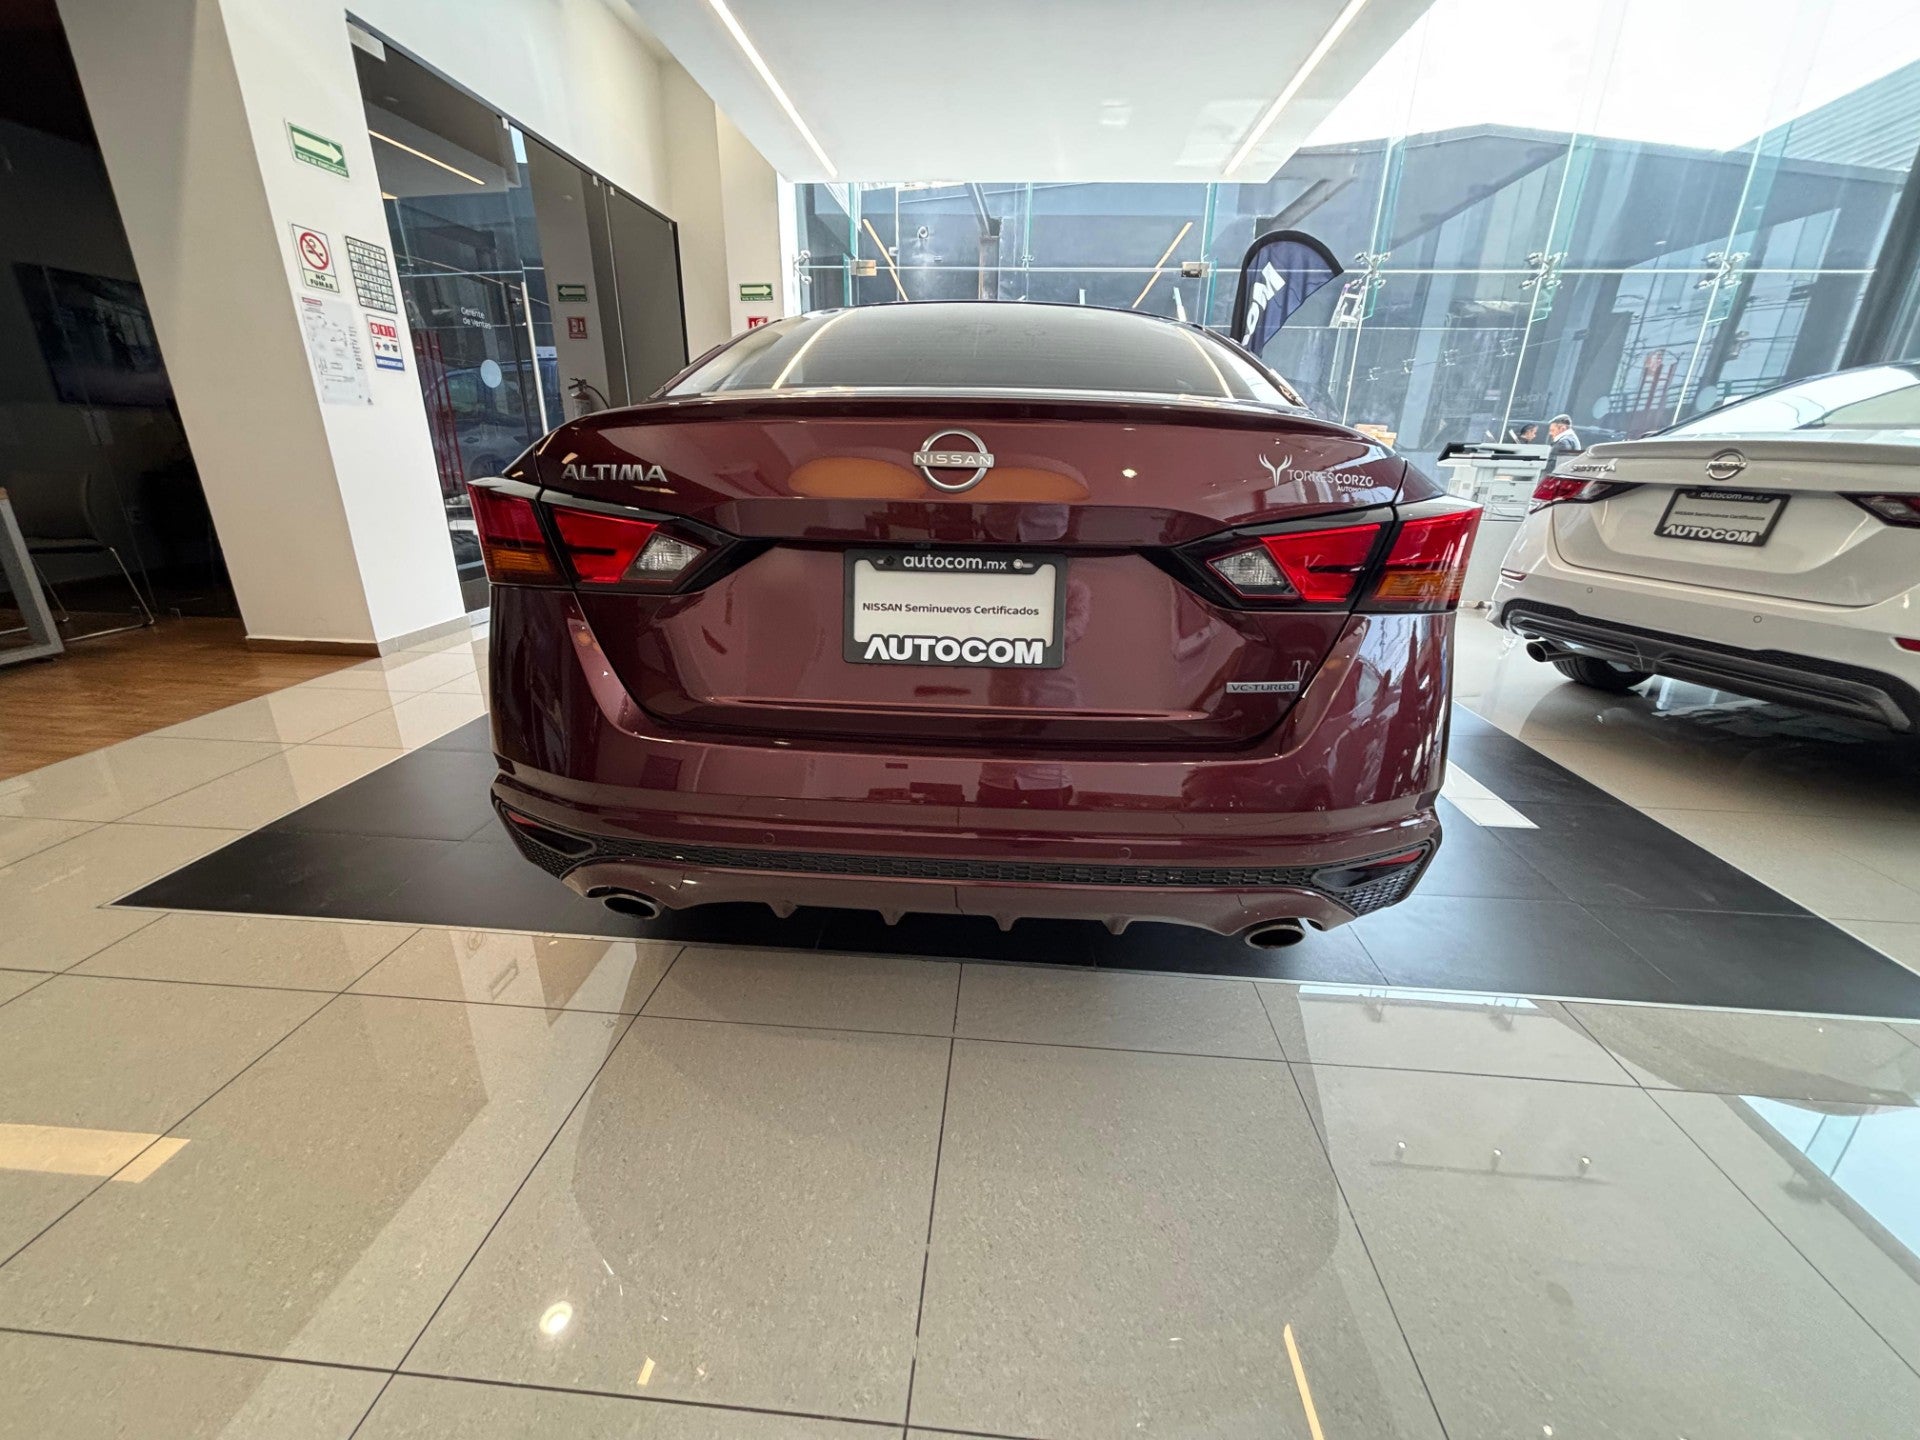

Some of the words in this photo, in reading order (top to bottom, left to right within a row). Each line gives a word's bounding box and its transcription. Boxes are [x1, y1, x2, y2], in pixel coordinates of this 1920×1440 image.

[310, 278, 334, 290] FUMAR
[371, 324, 395, 337] 911
[915, 454, 992, 466] NISSAN
[561, 463, 669, 482] ALTIMA
[1662, 525, 1758, 543] AUTOCOM
[902, 554, 1007, 570] autocom.mx
[862, 602, 903, 612] NISSAN
[904, 603, 972, 614] Seminuevos
[973, 605, 1040, 616] Certificados
[864, 636, 1044, 664] AUTOCOM
[1231, 683, 1296, 692] VC-TURBO
